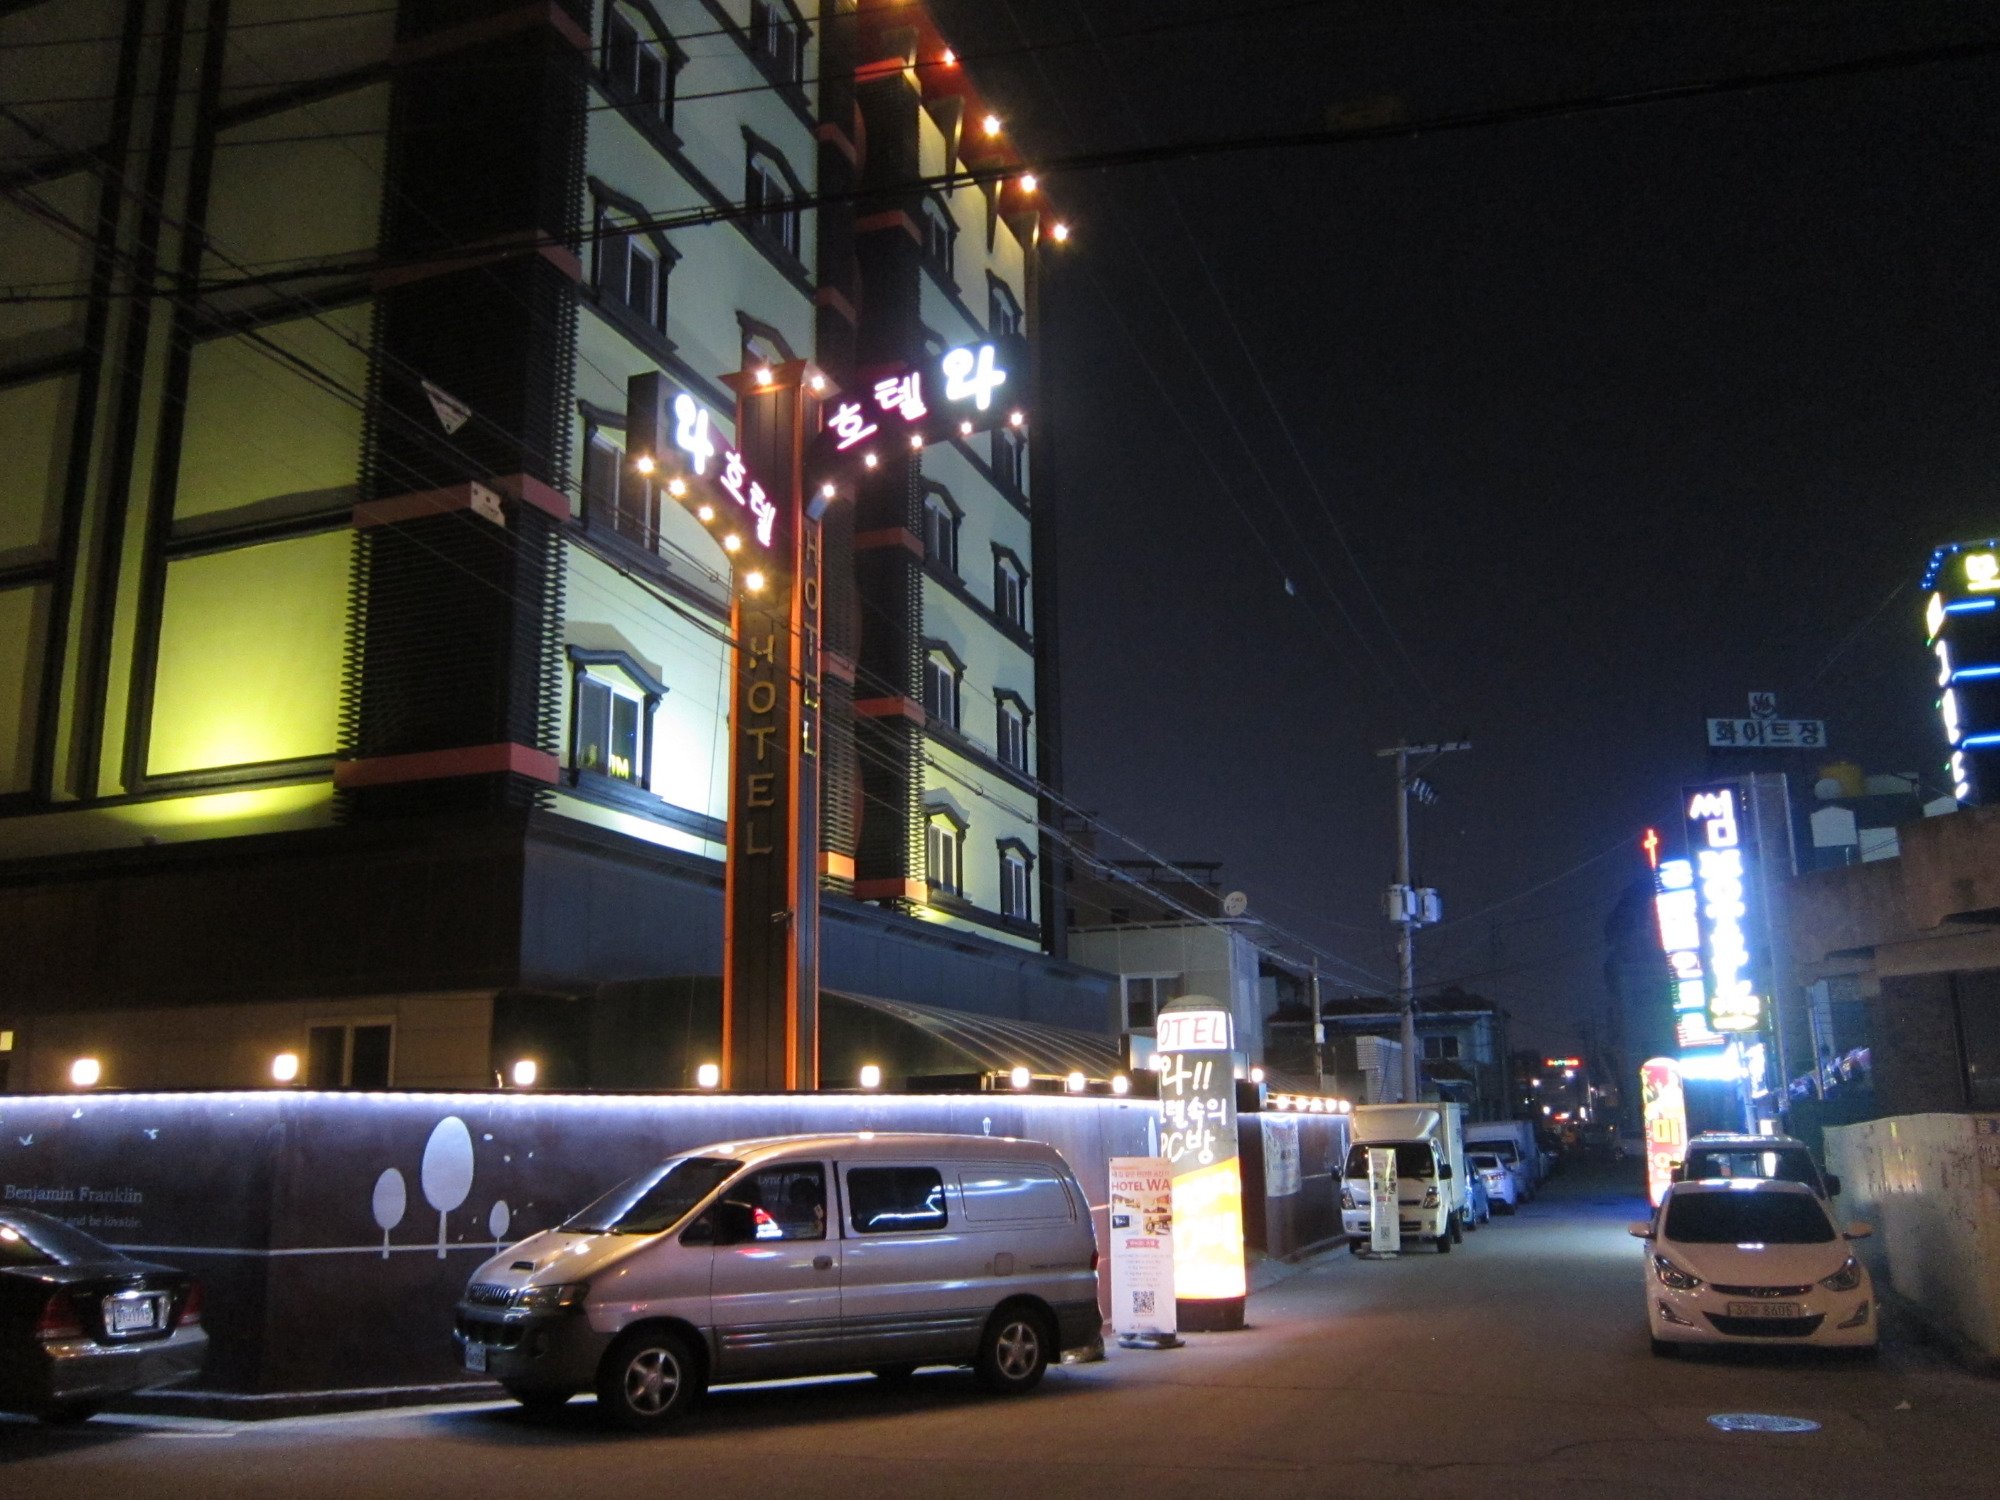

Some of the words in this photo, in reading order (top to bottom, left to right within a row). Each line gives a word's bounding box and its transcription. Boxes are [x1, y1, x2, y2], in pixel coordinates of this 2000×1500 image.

[828, 371, 927, 450] 호텔
[941, 344, 1006, 411] 와
[674, 392, 714, 475] 와
[720, 447, 776, 547] 호텔
[745, 634, 777, 855] HOTEL
[1715, 720, 1819, 745] 화이트장
[4, 1184, 75, 1204] Benjamin
[78, 1186, 143, 1204] Franklin
[1112, 1181, 1145, 1191] HOTEL
[1145, 1178, 1171, 1191] WA
